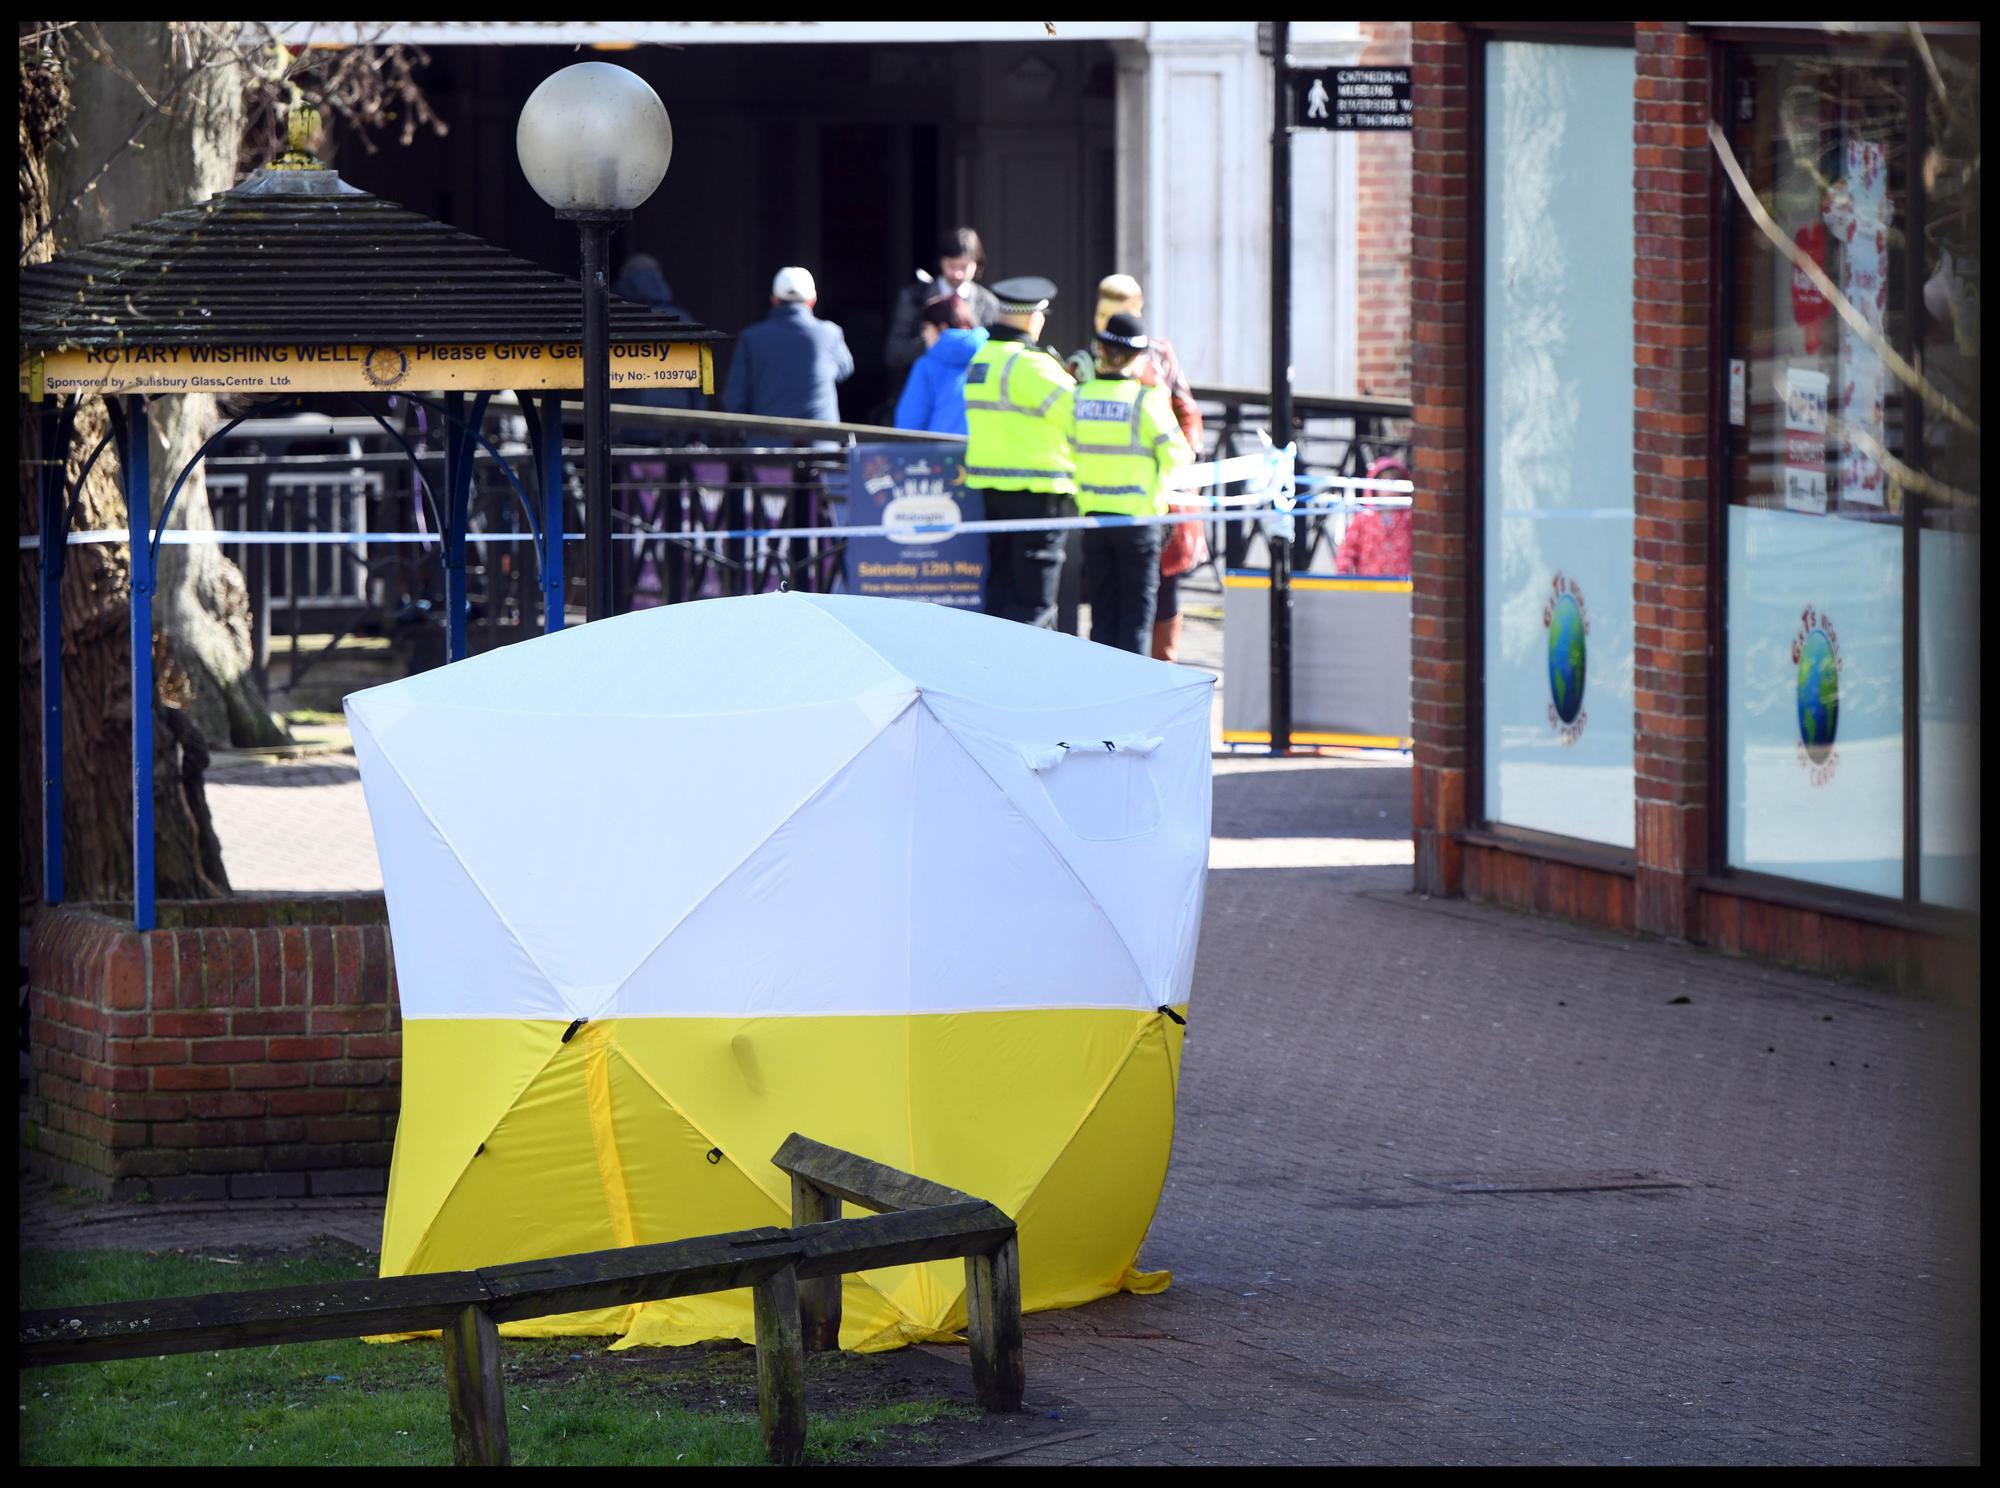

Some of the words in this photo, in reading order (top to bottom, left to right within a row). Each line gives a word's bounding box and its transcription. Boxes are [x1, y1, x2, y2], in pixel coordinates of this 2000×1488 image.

[87, 346, 181, 363] ROTARY
[190, 346, 288, 363] WISHING
[294, 345, 359, 362] WELL
[416, 344, 486, 360] Please
[494, 344, 541, 360] Give
[47, 377, 107, 389] Sponsored
[112, 377, 124, 388] by
[226, 376, 263, 386] Centre
[654, 370, 697, 380] 1039708
[1076, 401, 1126, 419] POLICE
[858, 562, 919, 578] Saturday
